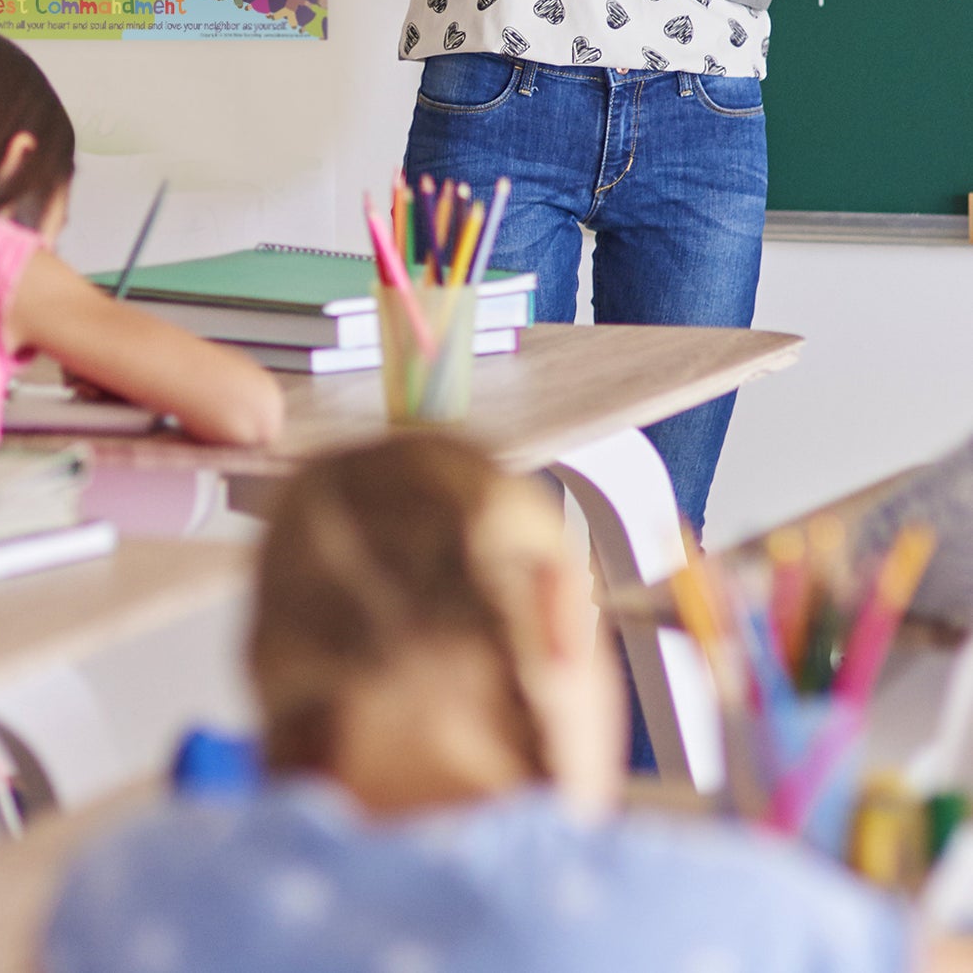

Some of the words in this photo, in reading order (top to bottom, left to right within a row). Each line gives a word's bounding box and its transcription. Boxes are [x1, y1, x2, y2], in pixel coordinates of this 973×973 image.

[27, 21, 45, 32] your
[48, 20, 69, 30] heart
[73, 21, 87, 30] and
[90, 20, 106, 30] soul
[109, 21, 123, 30] and
[127, 21, 146, 30] mind
[148, 21, 162, 30] and
[184, 22, 203, 32] your
